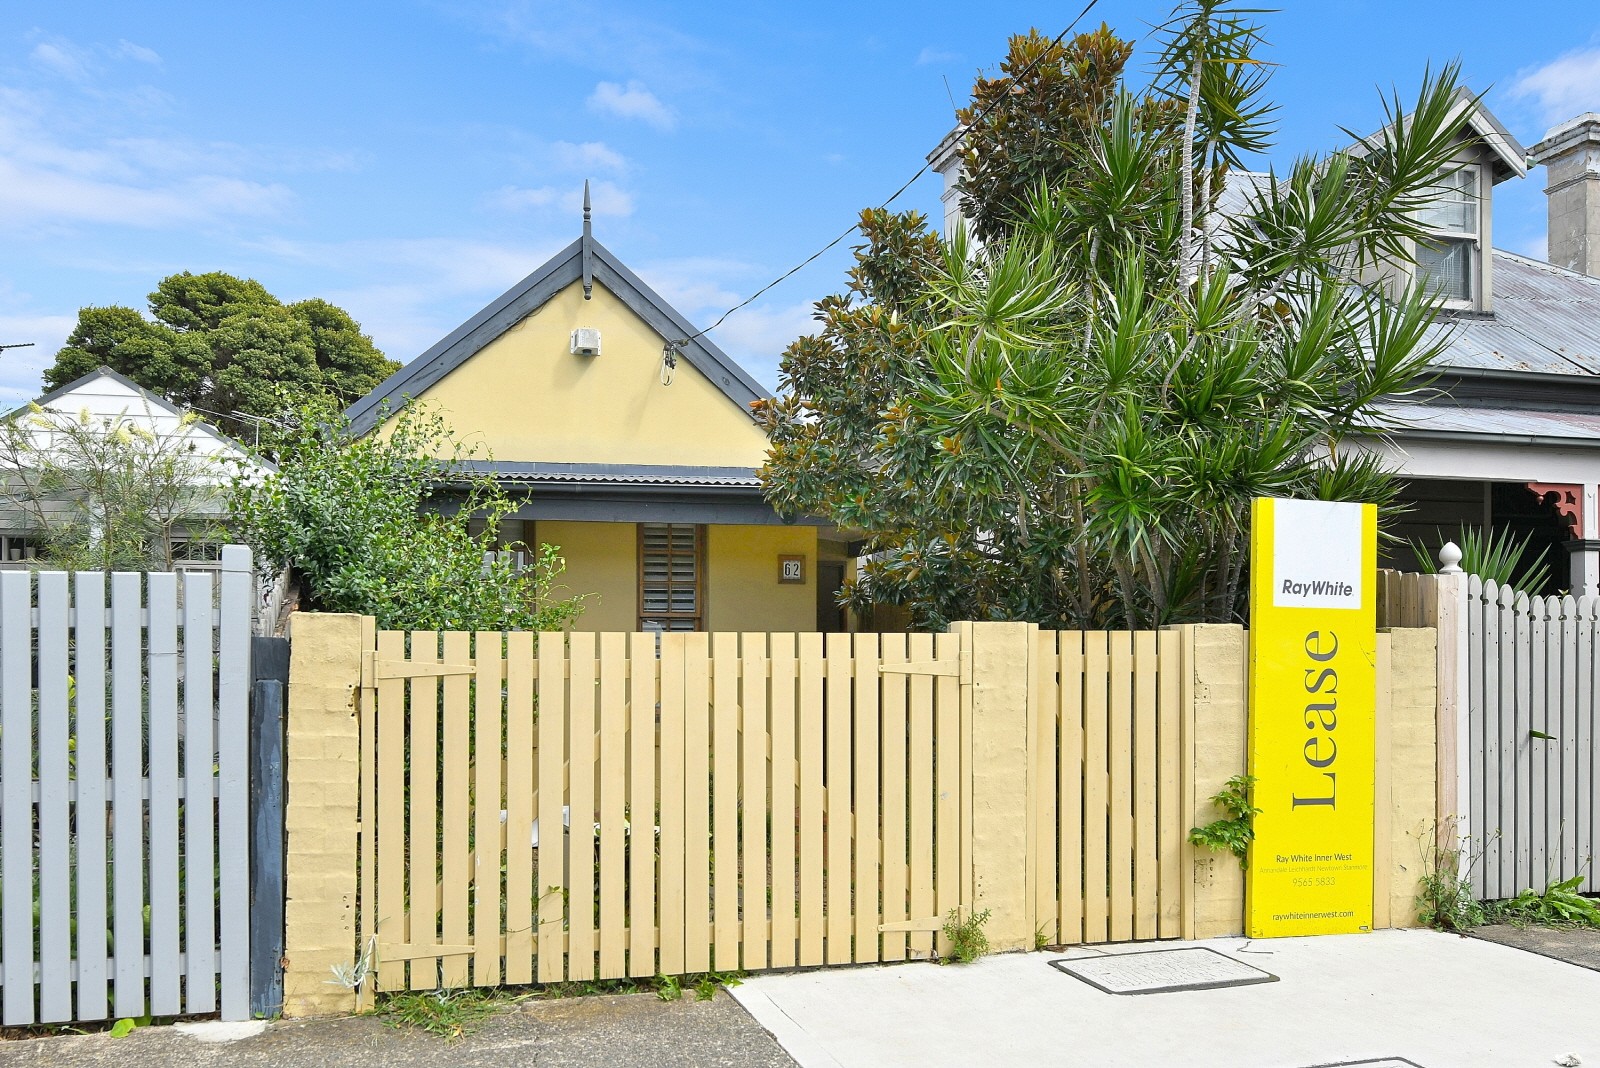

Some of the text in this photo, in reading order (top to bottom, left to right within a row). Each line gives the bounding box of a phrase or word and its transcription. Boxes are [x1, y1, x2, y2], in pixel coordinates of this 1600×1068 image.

[785, 563, 799, 576] 62
[1282, 579, 1353, 597] RayWhite
[1292, 630, 1338, 811] Lease
[1276, 852, 1352, 864] Ray White Inner West
[1292, 876, 1335, 887] 9565 5833
[1273, 910, 1354, 921] raywhiteinnerwest.com
